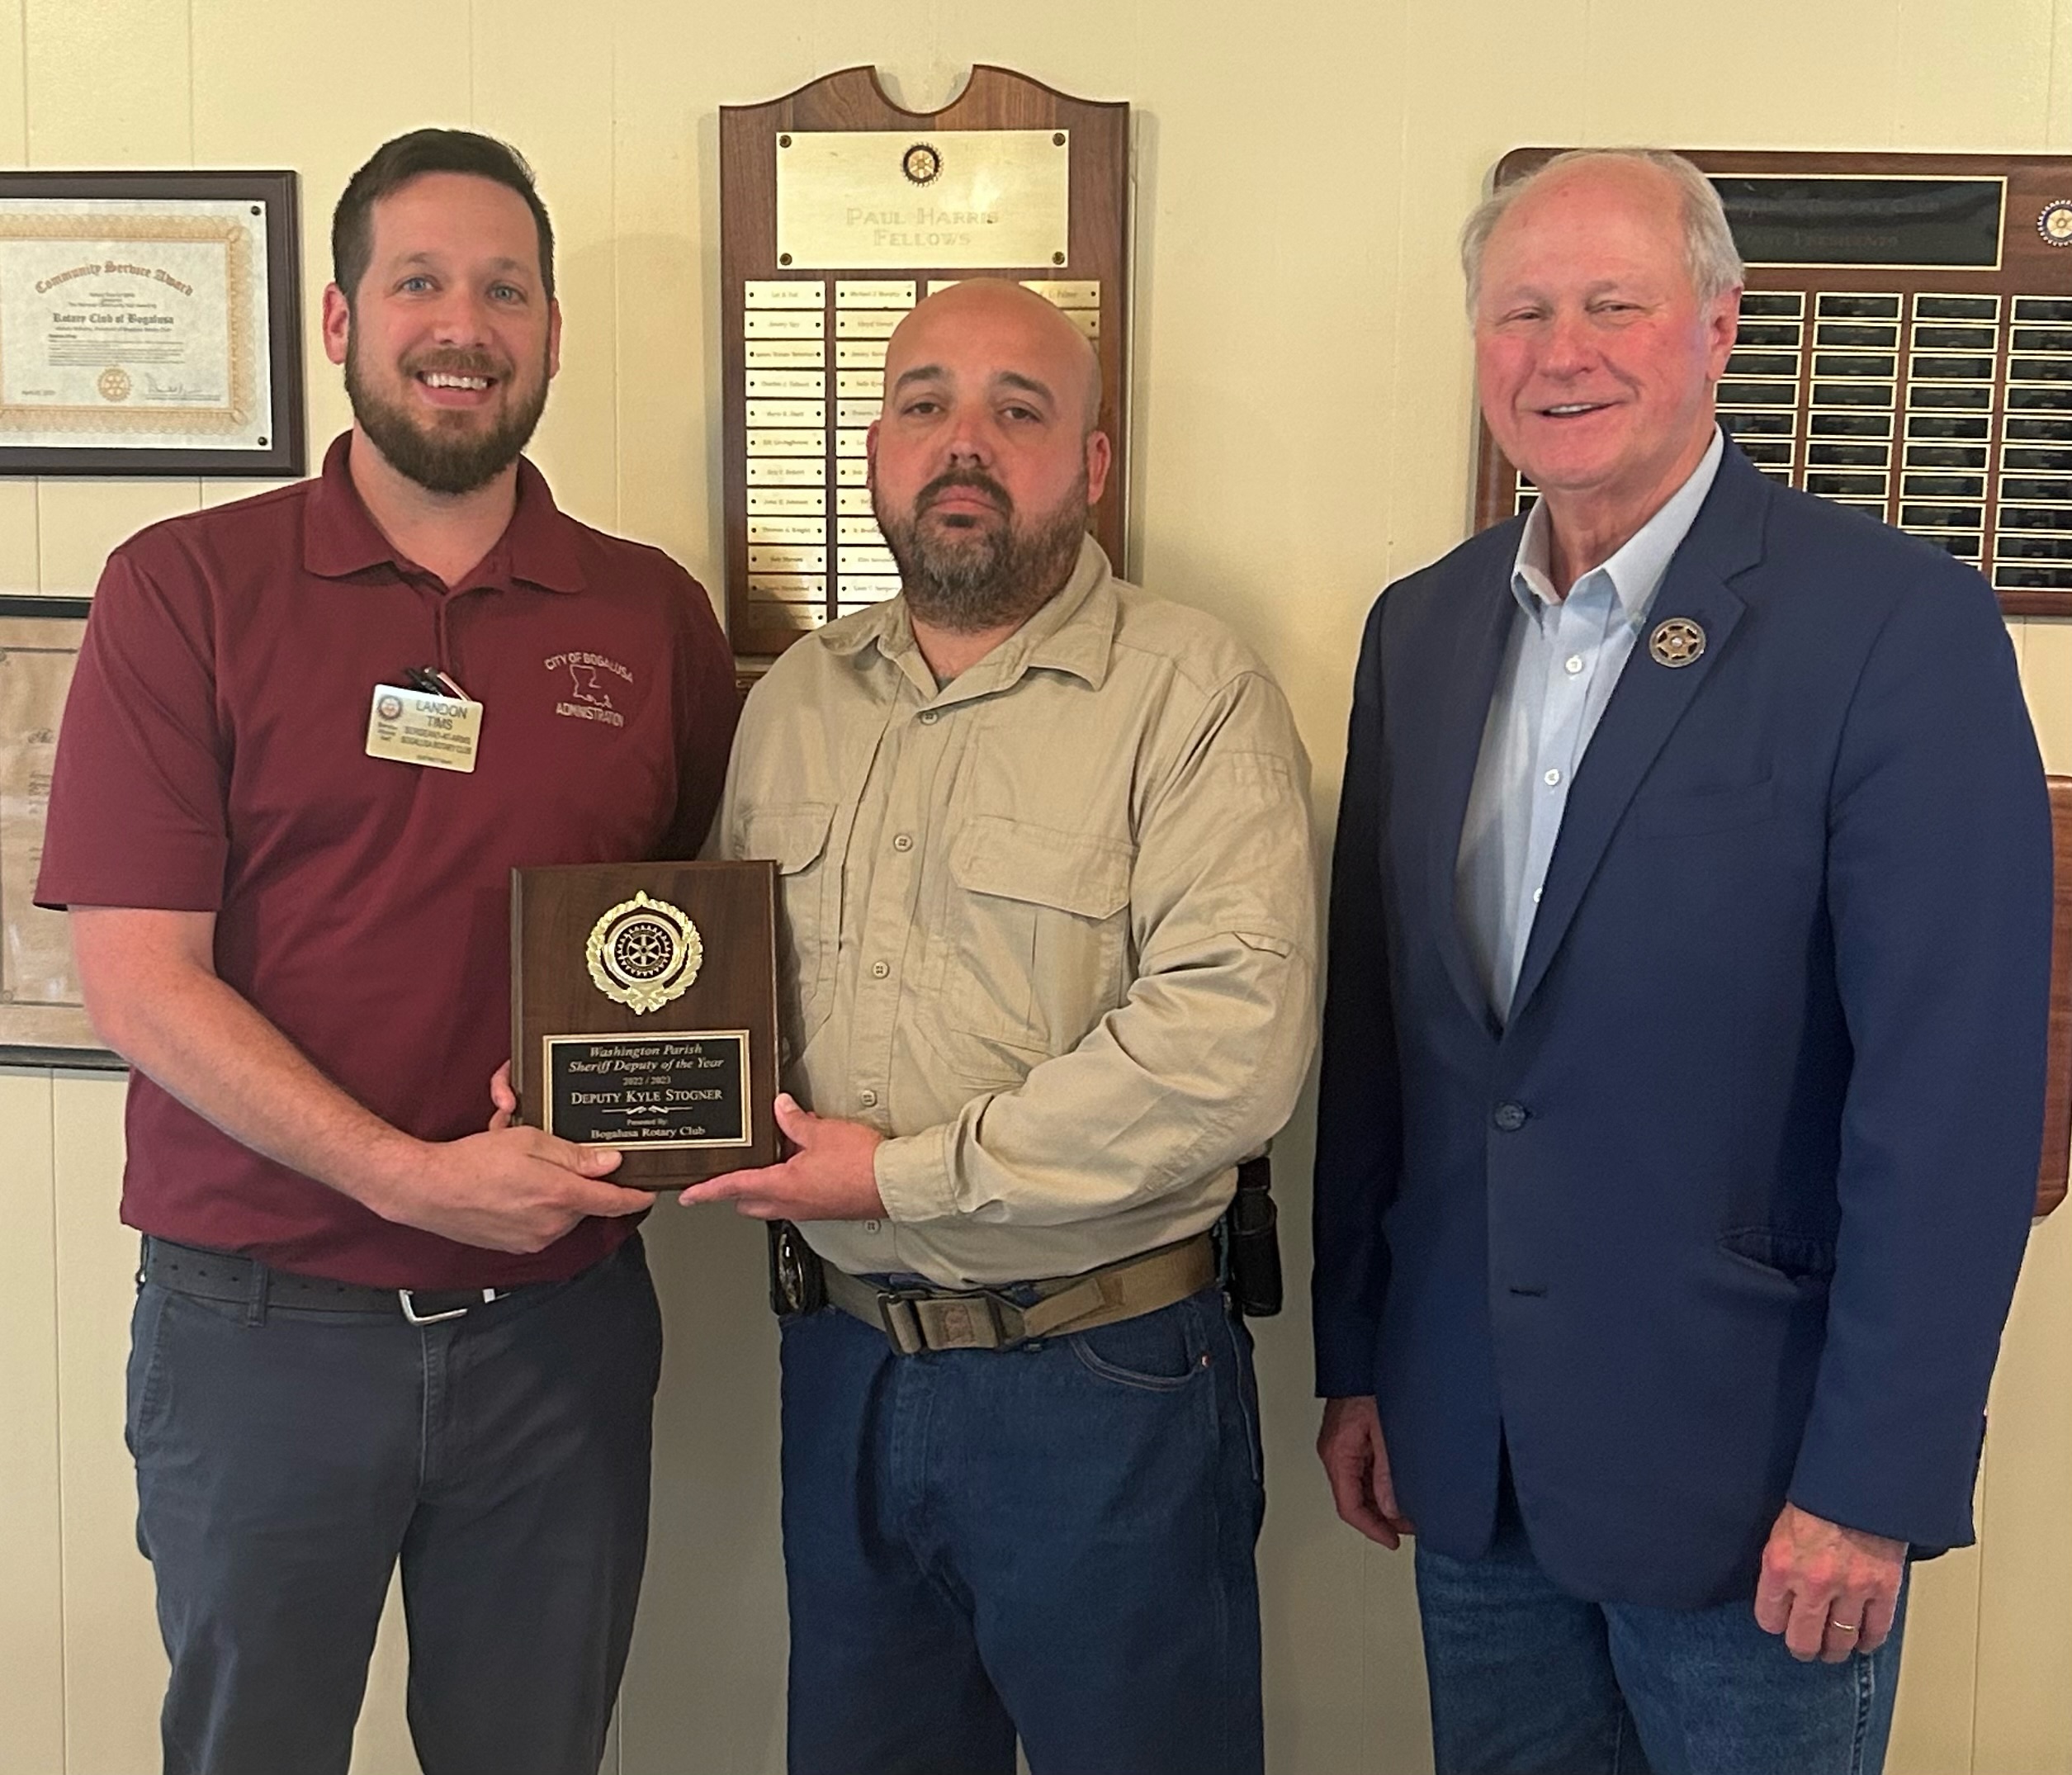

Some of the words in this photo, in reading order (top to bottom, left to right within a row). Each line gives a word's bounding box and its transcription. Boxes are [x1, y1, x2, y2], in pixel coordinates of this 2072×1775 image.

[845, 207, 906, 225] PAUL
[915, 207, 1000, 225] HARRIS
[873, 229, 972, 247] FELLOWS
[35, 263, 102, 294] Community
[104, 260, 152, 278] Service
[154, 268, 194, 296] Award
[53, 313, 86, 324] Rotary
[89, 313, 113, 324] Club
[544, 654, 567, 670] CITY
[568, 652, 582, 663] OF
[583, 652, 633, 684] BOGALUSA
[416, 699, 468, 720] LANDON
[556, 703, 624, 727] ADMINISTRATION
[426, 715, 453, 731] TIMS
[589, 1046, 660, 1059] Washington
[663, 1044, 702, 1055] Parish
[568, 1060, 613, 1074] Sheriff
[613, 1060, 659, 1073] Deputy
[660, 1058, 675, 1072] of
[675, 1058, 693, 1069] the
[698, 1057, 725, 1068] Year
[622, 1077, 644, 1086] 2022
[650, 1075, 672, 1085] 2023
[570, 1091, 622, 1105] DEPUTY
[626, 1090, 661, 1103] KYLE
[665, 1088, 723, 1101] STOGNER
[590, 1129, 639, 1140] Bogalusa
[641, 1128, 676, 1138] Rotary
[679, 1126, 706, 1136] Club
